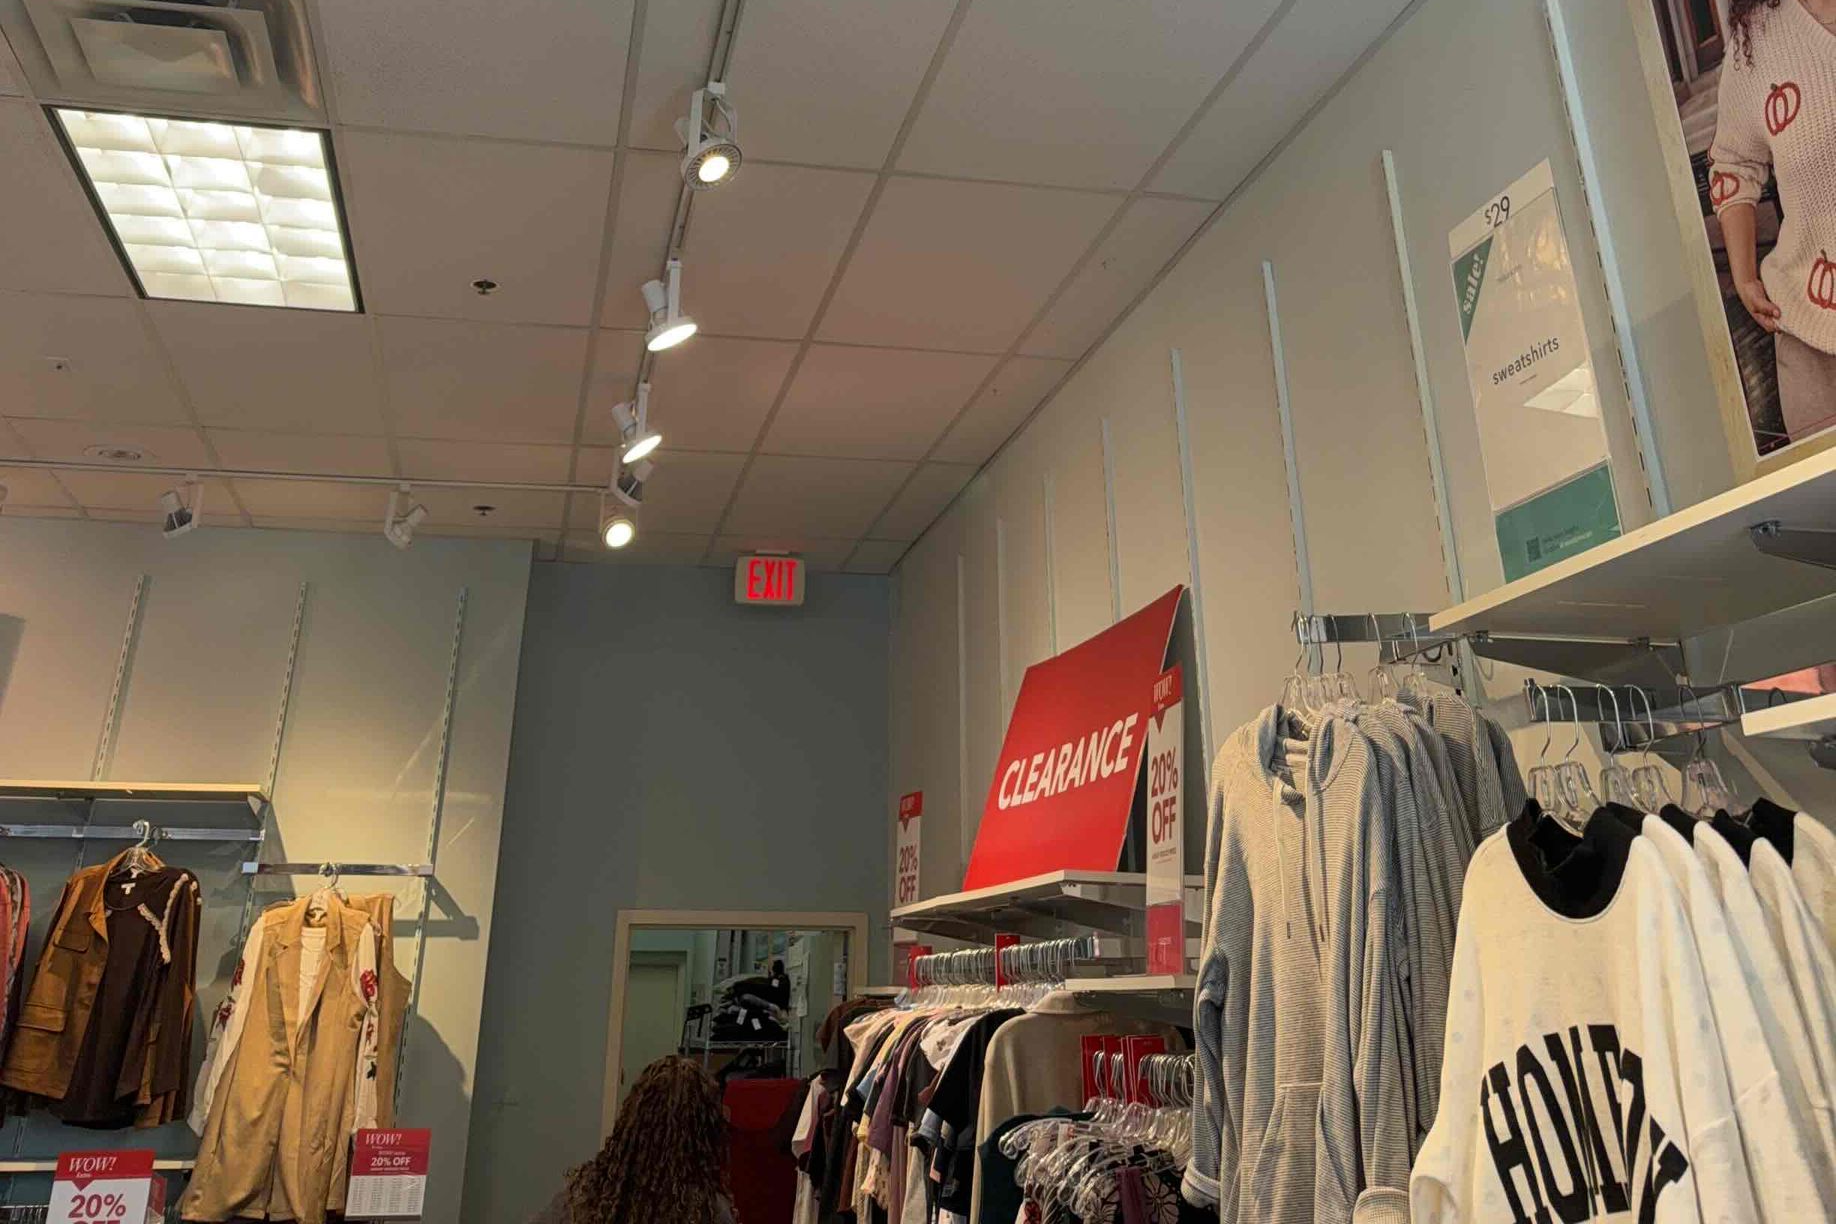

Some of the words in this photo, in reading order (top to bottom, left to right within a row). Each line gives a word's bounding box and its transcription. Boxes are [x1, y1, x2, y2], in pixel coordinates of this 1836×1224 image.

[1484, 195, 1510, 228] $29
[1463, 253, 1484, 315] sale!
[1492, 337, 1560, 385] sweatshirts
[747, 558, 797, 601] EXIT
[998, 712, 1139, 811] CLEARANCE
[1151, 747, 1178, 797] 20%
[1151, 796, 1177, 845] OFF
[365, 1133, 402, 1146] WOW!
[69, 1156, 117, 1173] WOW!
[370, 1156, 392, 1167] 20%
[393, 1156, 412, 1166] OFF
[68, 1193, 127, 1219] 20%
